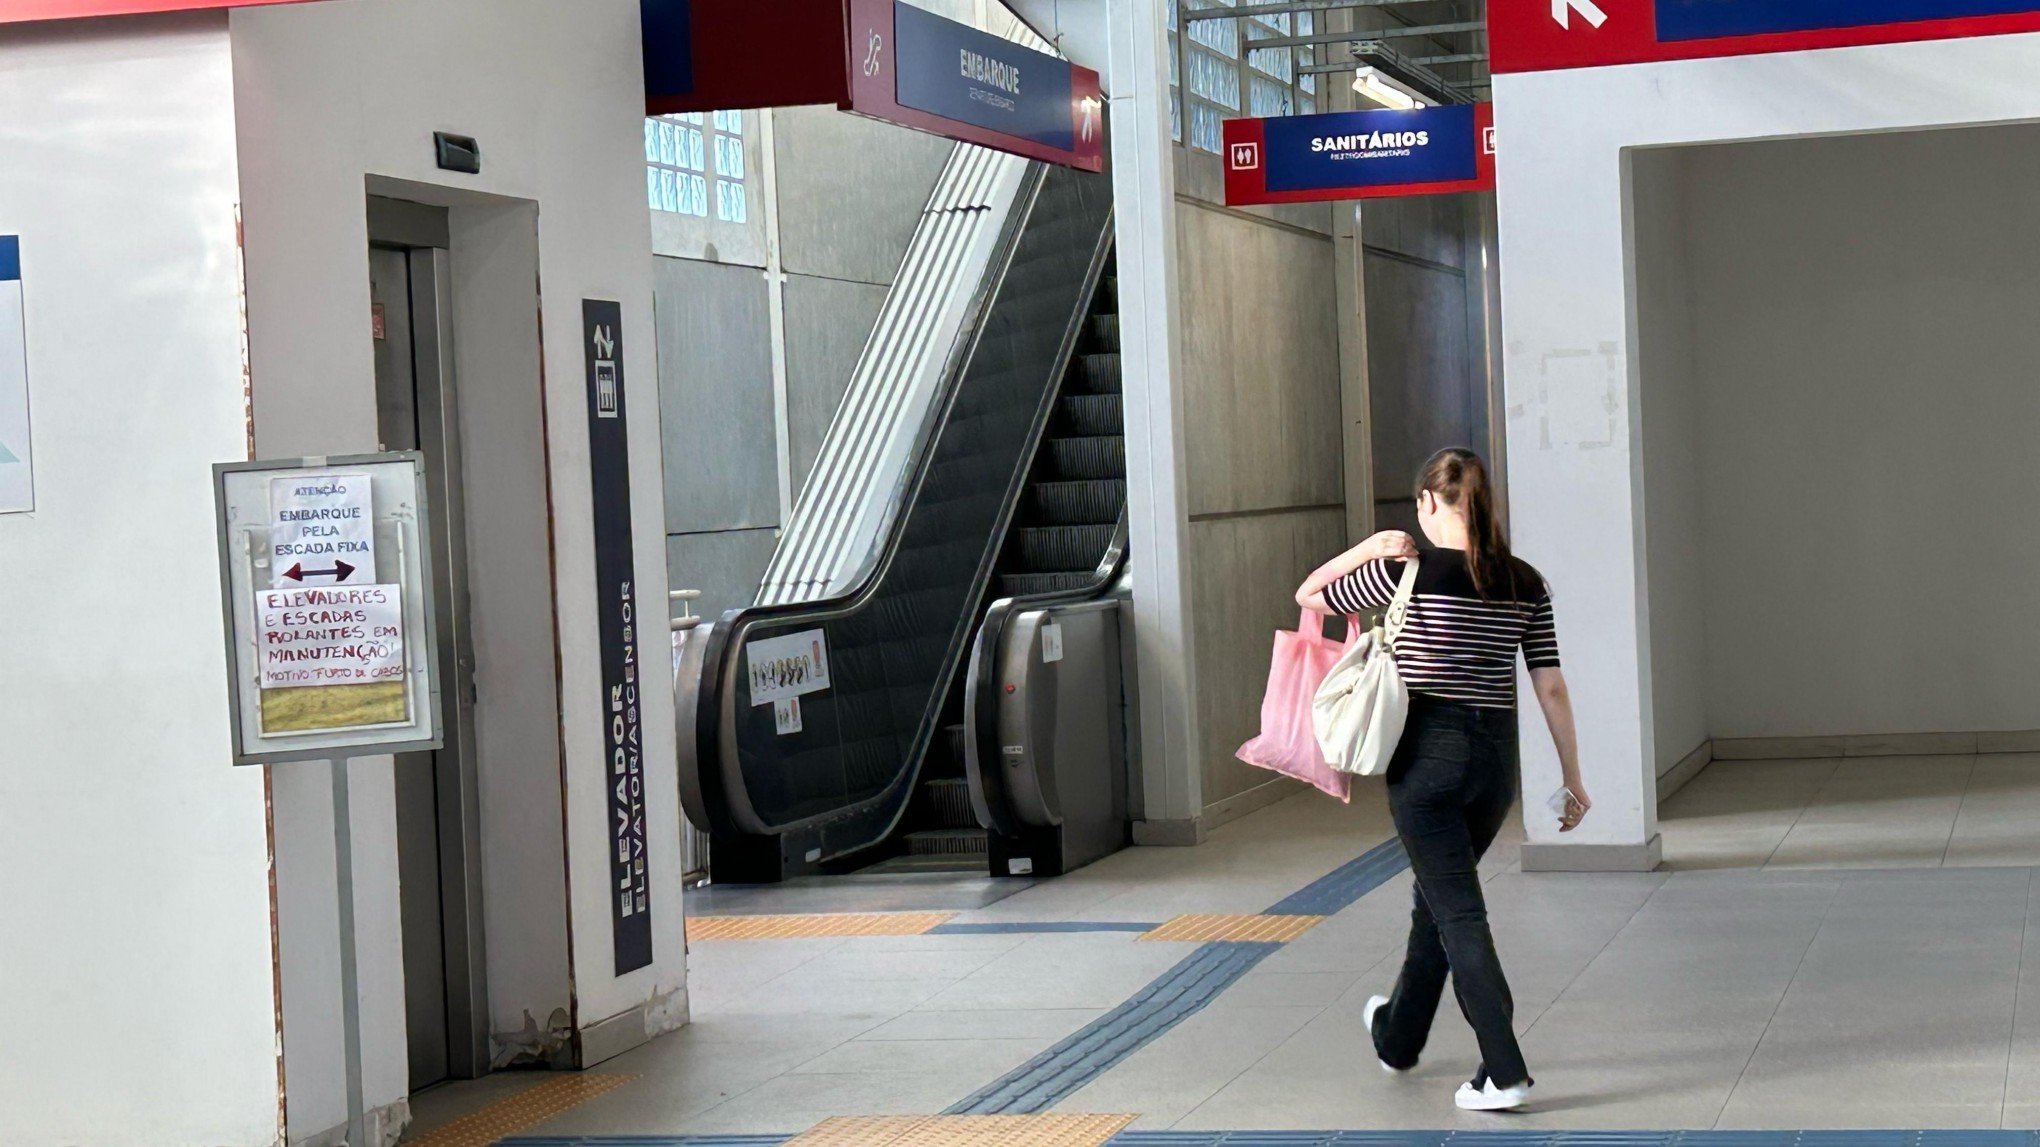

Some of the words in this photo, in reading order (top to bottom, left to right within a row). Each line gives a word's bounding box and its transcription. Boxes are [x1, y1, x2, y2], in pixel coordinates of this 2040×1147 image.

[960, 48, 1020, 95] EMBARQUE
[1311, 130, 1429, 152] SANITÁRIOS
[294, 484, 347, 497] ATENÇÃO
[279, 507, 361, 521] EMBARQUE
[302, 526, 340, 537] PELA
[275, 543, 335, 556] ESCADA
[337, 541, 370, 553] FIXA
[266, 589, 387, 609] ELEVADORES
[265, 614, 277, 627] E
[282, 610, 367, 626] ESCADAS
[265, 625, 365, 644] ROLANTES
[373, 626, 398, 638] EM
[621, 579, 646, 913] ELEVATOR/ASCENSOR
[611, 683, 633, 918] ELEVADOR
